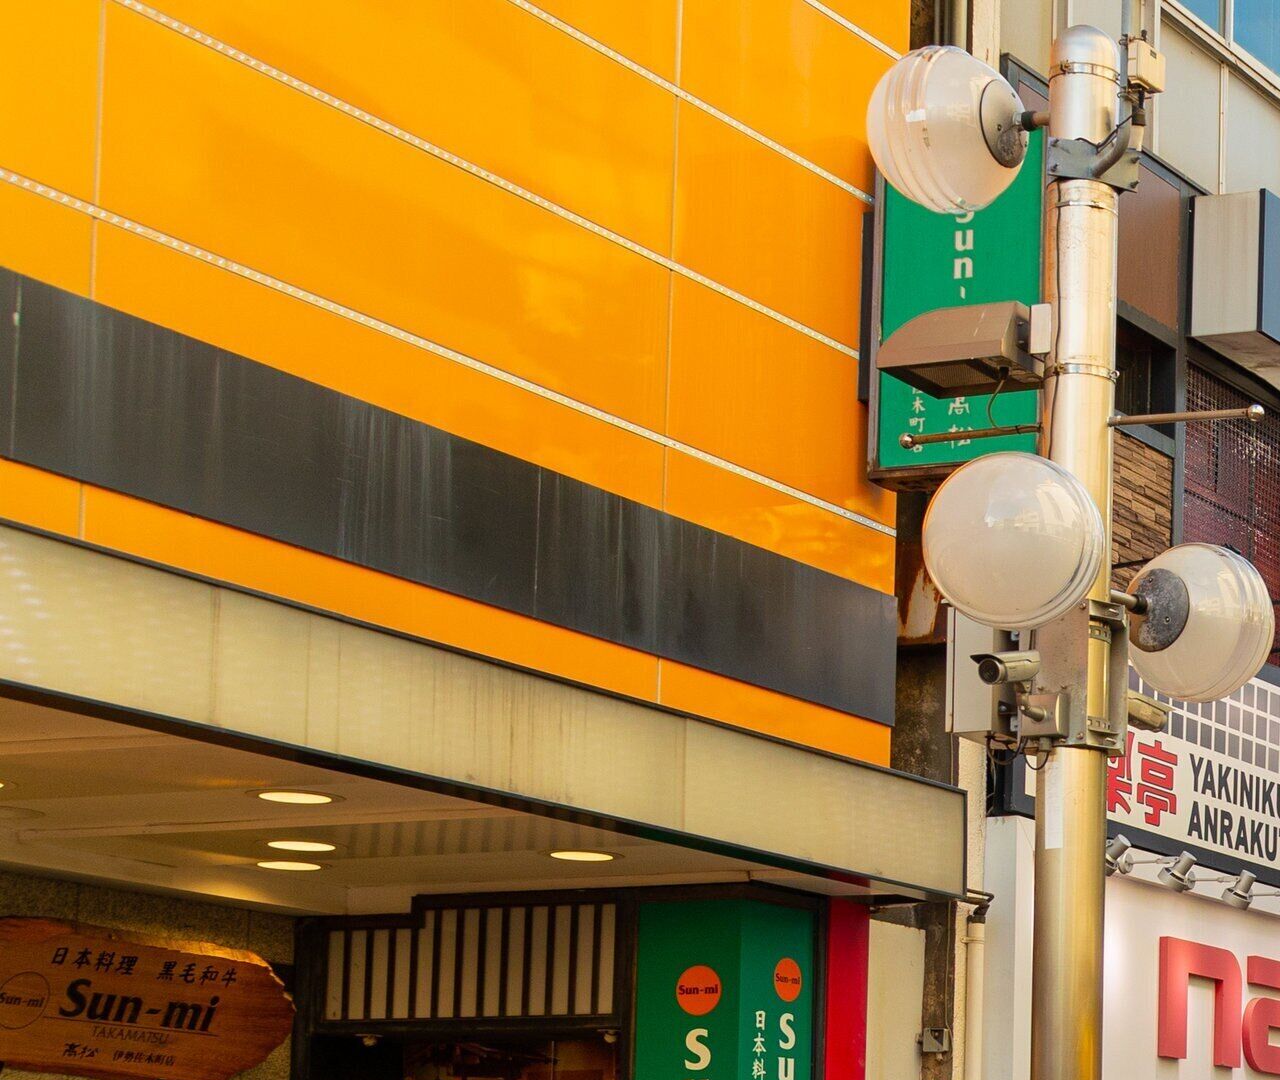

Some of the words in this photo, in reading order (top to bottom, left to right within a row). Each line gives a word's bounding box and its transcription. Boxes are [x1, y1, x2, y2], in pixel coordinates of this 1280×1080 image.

[50, 947, 140, 976] 日本料理
[156, 960, 239, 988] 黒毛和牛
[775, 972, 800, 985] Sun-mi
[678, 984, 719, 996] Sun-mi
[58, 977, 221, 1032] Sun-mi
[91, 1025, 174, 1045] TAKAMATSU
[112, 1050, 176, 1067] 伊勢佐木町店
